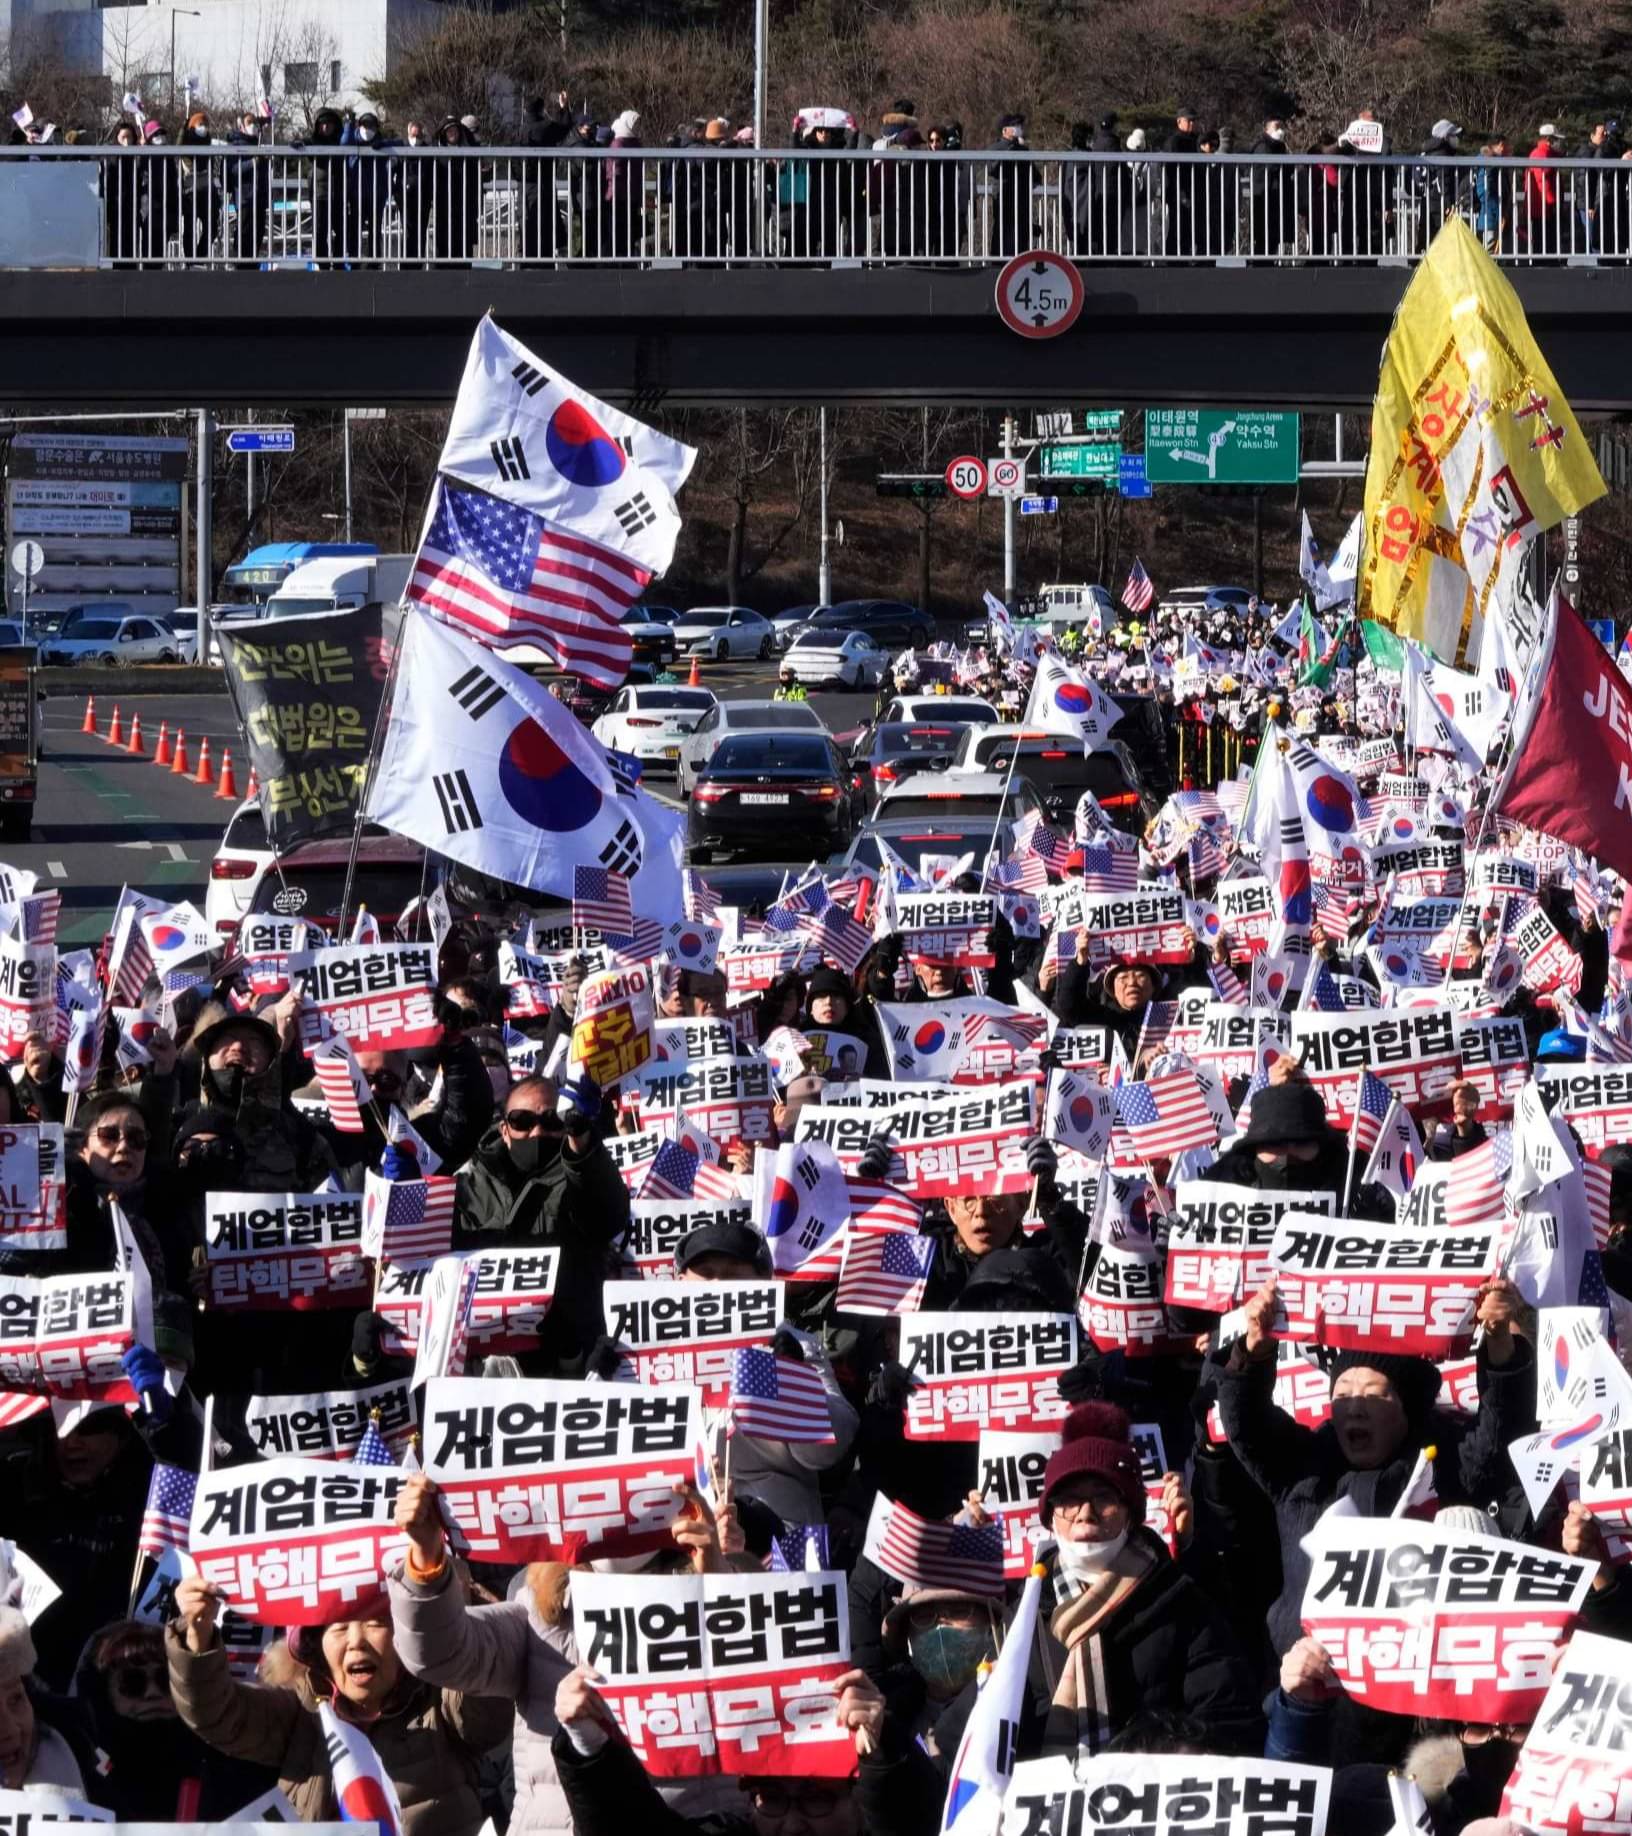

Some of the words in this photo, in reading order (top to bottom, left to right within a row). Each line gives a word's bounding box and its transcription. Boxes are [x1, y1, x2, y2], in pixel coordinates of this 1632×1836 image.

[1014, 277, 1067, 311] 4.5m
[1150, 410, 1199, 424] 이태원역
[1236, 425, 1275, 438] 약수역
[1184, 438, 1199, 448] Stn
[1237, 440, 1262, 448] Yaksu
[1264, 440, 1278, 448] Stn
[956, 467, 978, 487] 50
[1374, 849, 1462, 874] 계엄합법
[1482, 863, 1536, 886] 엄합법
[900, 902, 995, 929] 계엄합법
[1089, 899, 1183, 929] 계엄합법
[1388, 902, 1481, 928] 계엄합법
[299, 953, 432, 999] 계엄합법
[305, 1000, 438, 1043] 탄핵무효
[1297, 1009, 1451, 1070] 계엄합법
[646, 1065, 768, 1105] 계엄합법
[959, 1051, 1040, 1075] 핵무효
[885, 1091, 1033, 1136] 계엄합법
[1313, 1065, 1459, 1119] 탄무효
[895, 1140, 1023, 1183] 탄핵무효
[213, 1203, 362, 1248] 계엄합법
[1278, 1230, 1491, 1270] 계엄합법
[213, 1256, 367, 1302] 탄핵무효
[384, 1254, 551, 1294] 계합법
[1095, 1252, 1160, 1298] 엄합
[0, 1281, 125, 1337] 엄합법
[377, 1303, 546, 1350] 탄무효
[611, 1289, 777, 1344] 계엄합법
[1273, 1282, 1477, 1336] 탄핵무효
[0, 1342, 125, 1388] 핵무효
[907, 1320, 1070, 1377] 계엄합법
[620, 1350, 733, 1403] 탄핵무
[909, 1378, 1071, 1435] 탄핵무효
[433, 1395, 690, 1469] 계엄합법
[982, 1453, 1047, 1501] 계엄
[450, 1471, 690, 1549] 탄핵무효
[1316, 1543, 1586, 1607] 계엄합법
[583, 1584, 840, 1673] 계엄합법
[1313, 1617, 1564, 1695] 탄핵무효
[613, 1678, 850, 1760] 탄핵무효
